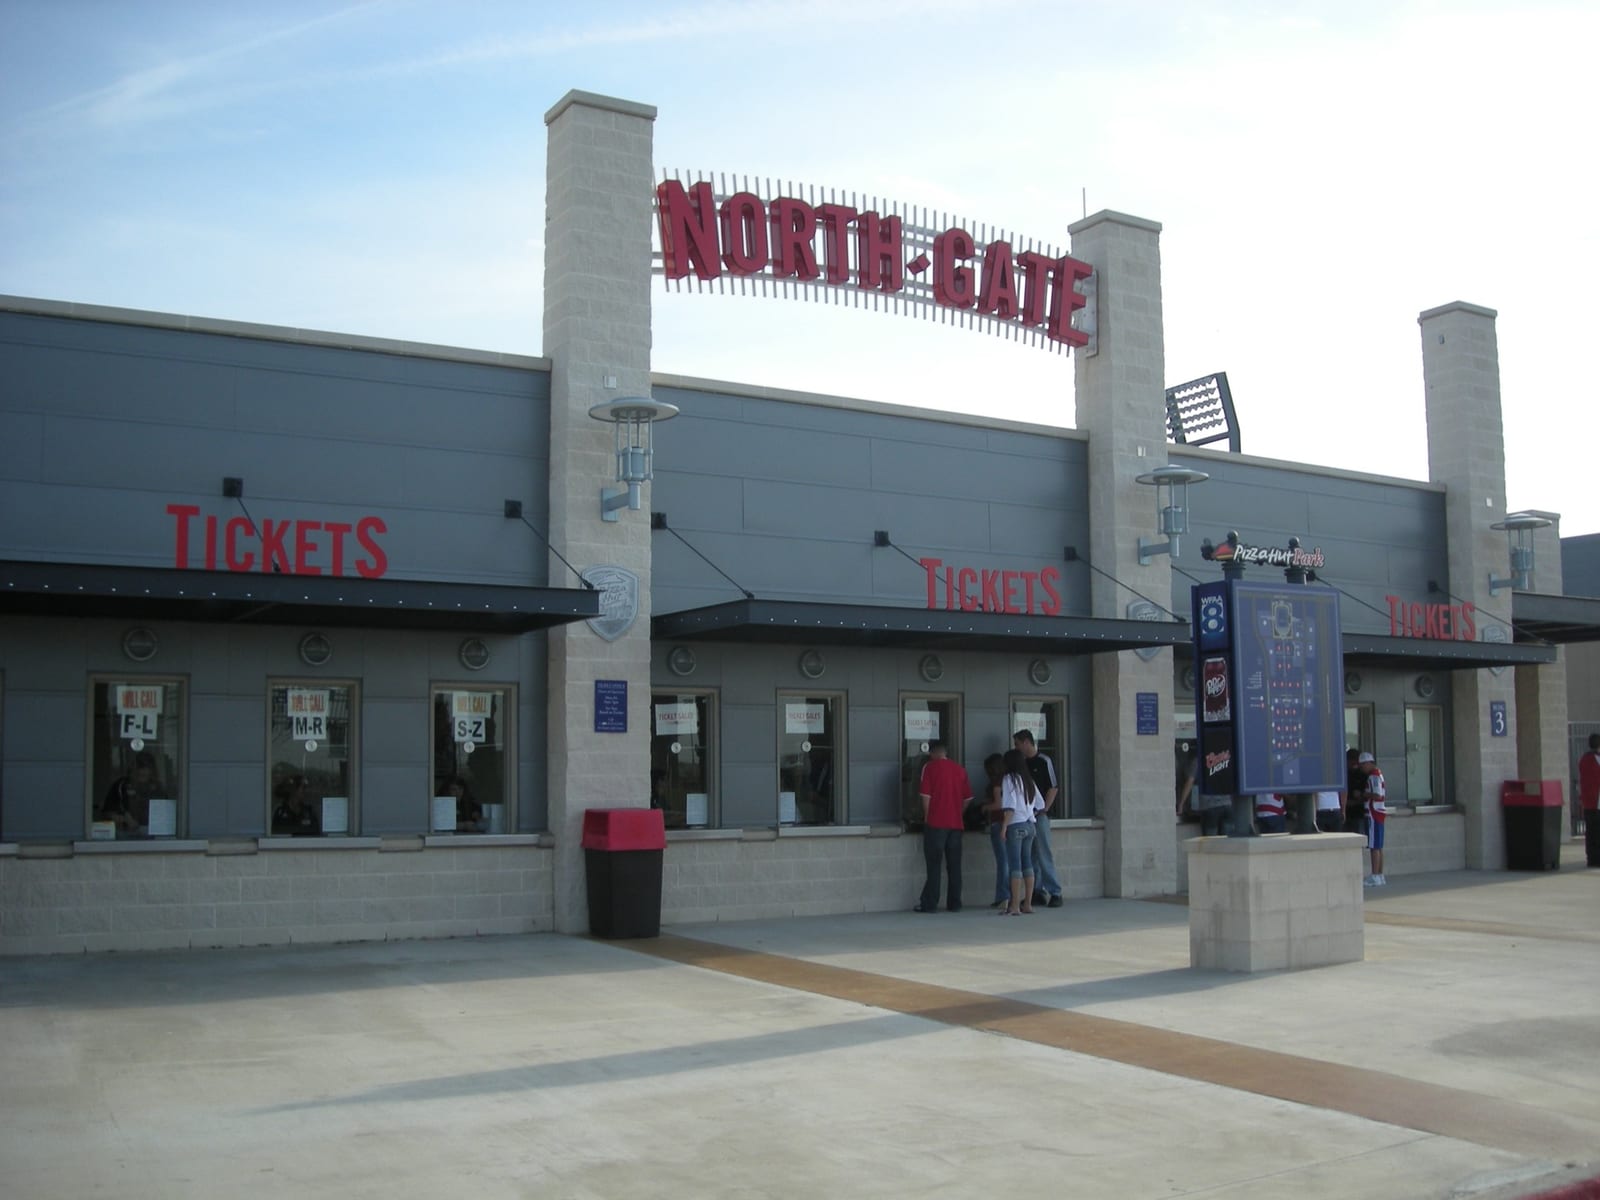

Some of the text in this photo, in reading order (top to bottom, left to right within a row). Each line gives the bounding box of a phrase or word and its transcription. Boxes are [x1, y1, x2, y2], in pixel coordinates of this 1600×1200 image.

[658, 179, 1092, 348] NORTH GATE
[166, 504, 388, 580] TICKETS
[1292, 547, 1325, 567] Park
[920, 557, 1063, 616] TICKETS
[1202, 603, 1224, 634] 8
[1384, 593, 1477, 641] TICKETS
[124, 714, 154, 735] F-L
[295, 716, 323, 736] M-R
[457, 720, 483, 738] S-Z
[1495, 711, 1505, 734] 3
